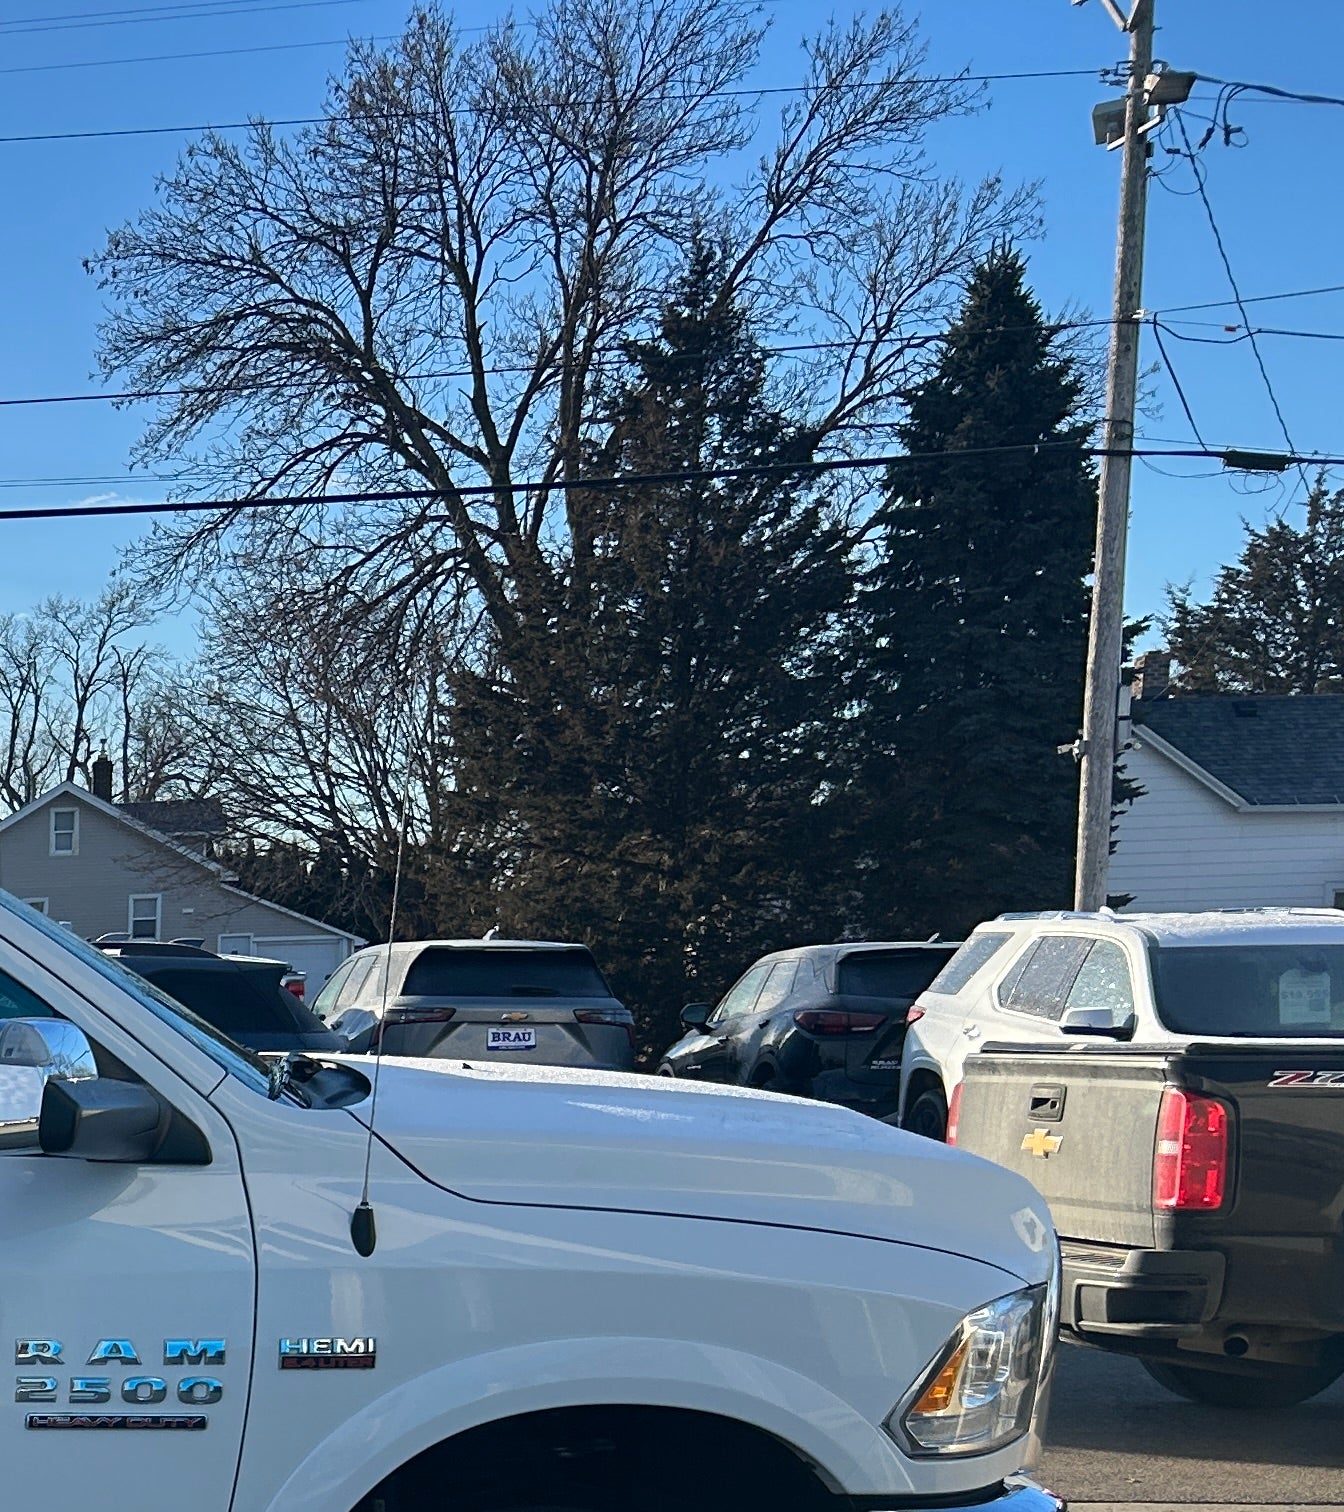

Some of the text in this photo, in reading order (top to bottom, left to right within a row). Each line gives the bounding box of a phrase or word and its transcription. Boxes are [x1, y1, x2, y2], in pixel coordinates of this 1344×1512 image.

[491, 1031, 532, 1043] BRAU
[15, 1338, 226, 1366] RAM
[280, 1338, 376, 1354] HEMI
[15, 1376, 223, 1404] 2500
[32, 1415, 203, 1428] HEAVY DUTY
